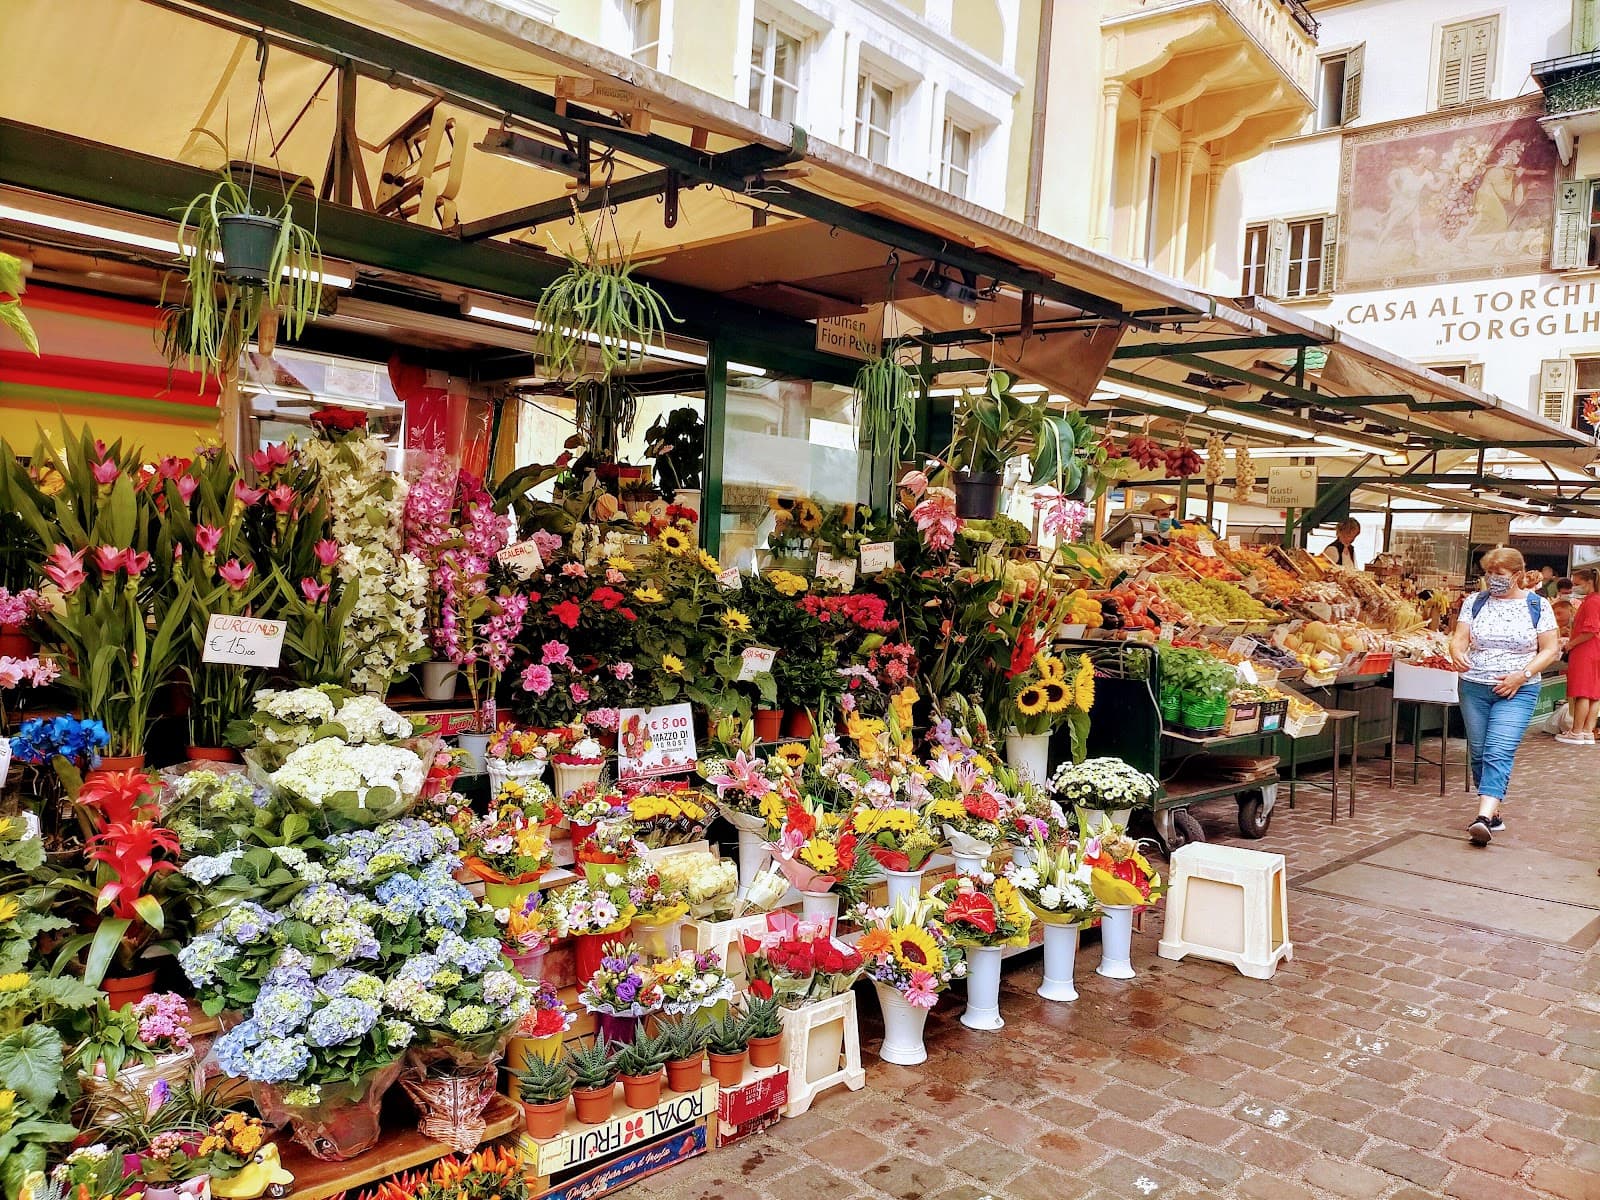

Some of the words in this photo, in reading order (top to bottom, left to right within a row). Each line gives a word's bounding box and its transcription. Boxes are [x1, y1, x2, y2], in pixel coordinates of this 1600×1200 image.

[1428, 296, 1464, 318] AL
[1474, 283, 1595, 313] TORCHI
[821, 327, 846, 347] Fiori
[1270, 486, 1293, 495] Gusti
[1269, 495, 1299, 505] Italiani
[652, 731, 678, 743] MAZZO
[680, 730, 689, 739] DI
[666, 739, 688, 748] ROSE
[645, 1086, 704, 1135] ROYAL
[564, 1122, 621, 1167] FRUIT
